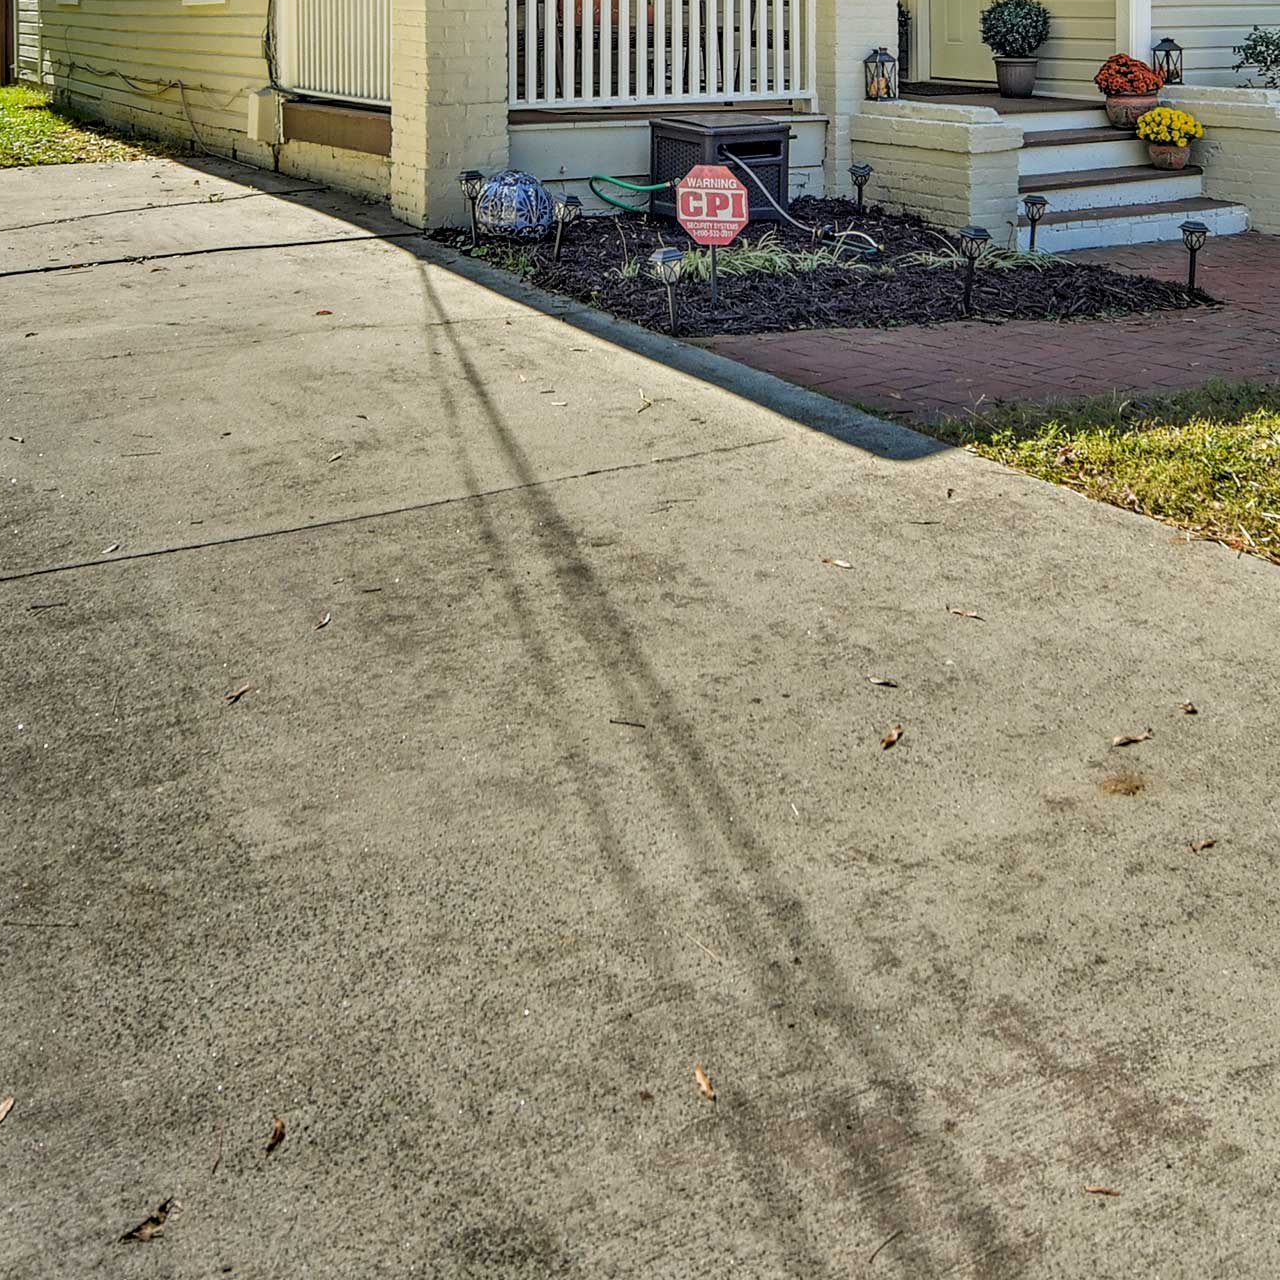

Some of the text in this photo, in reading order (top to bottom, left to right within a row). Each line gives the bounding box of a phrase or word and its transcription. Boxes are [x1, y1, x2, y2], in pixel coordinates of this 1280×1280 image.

[687, 178, 737, 189] WARNING
[681, 190, 745, 218] CPI
[714, 222, 738, 230] SYSTEMS
